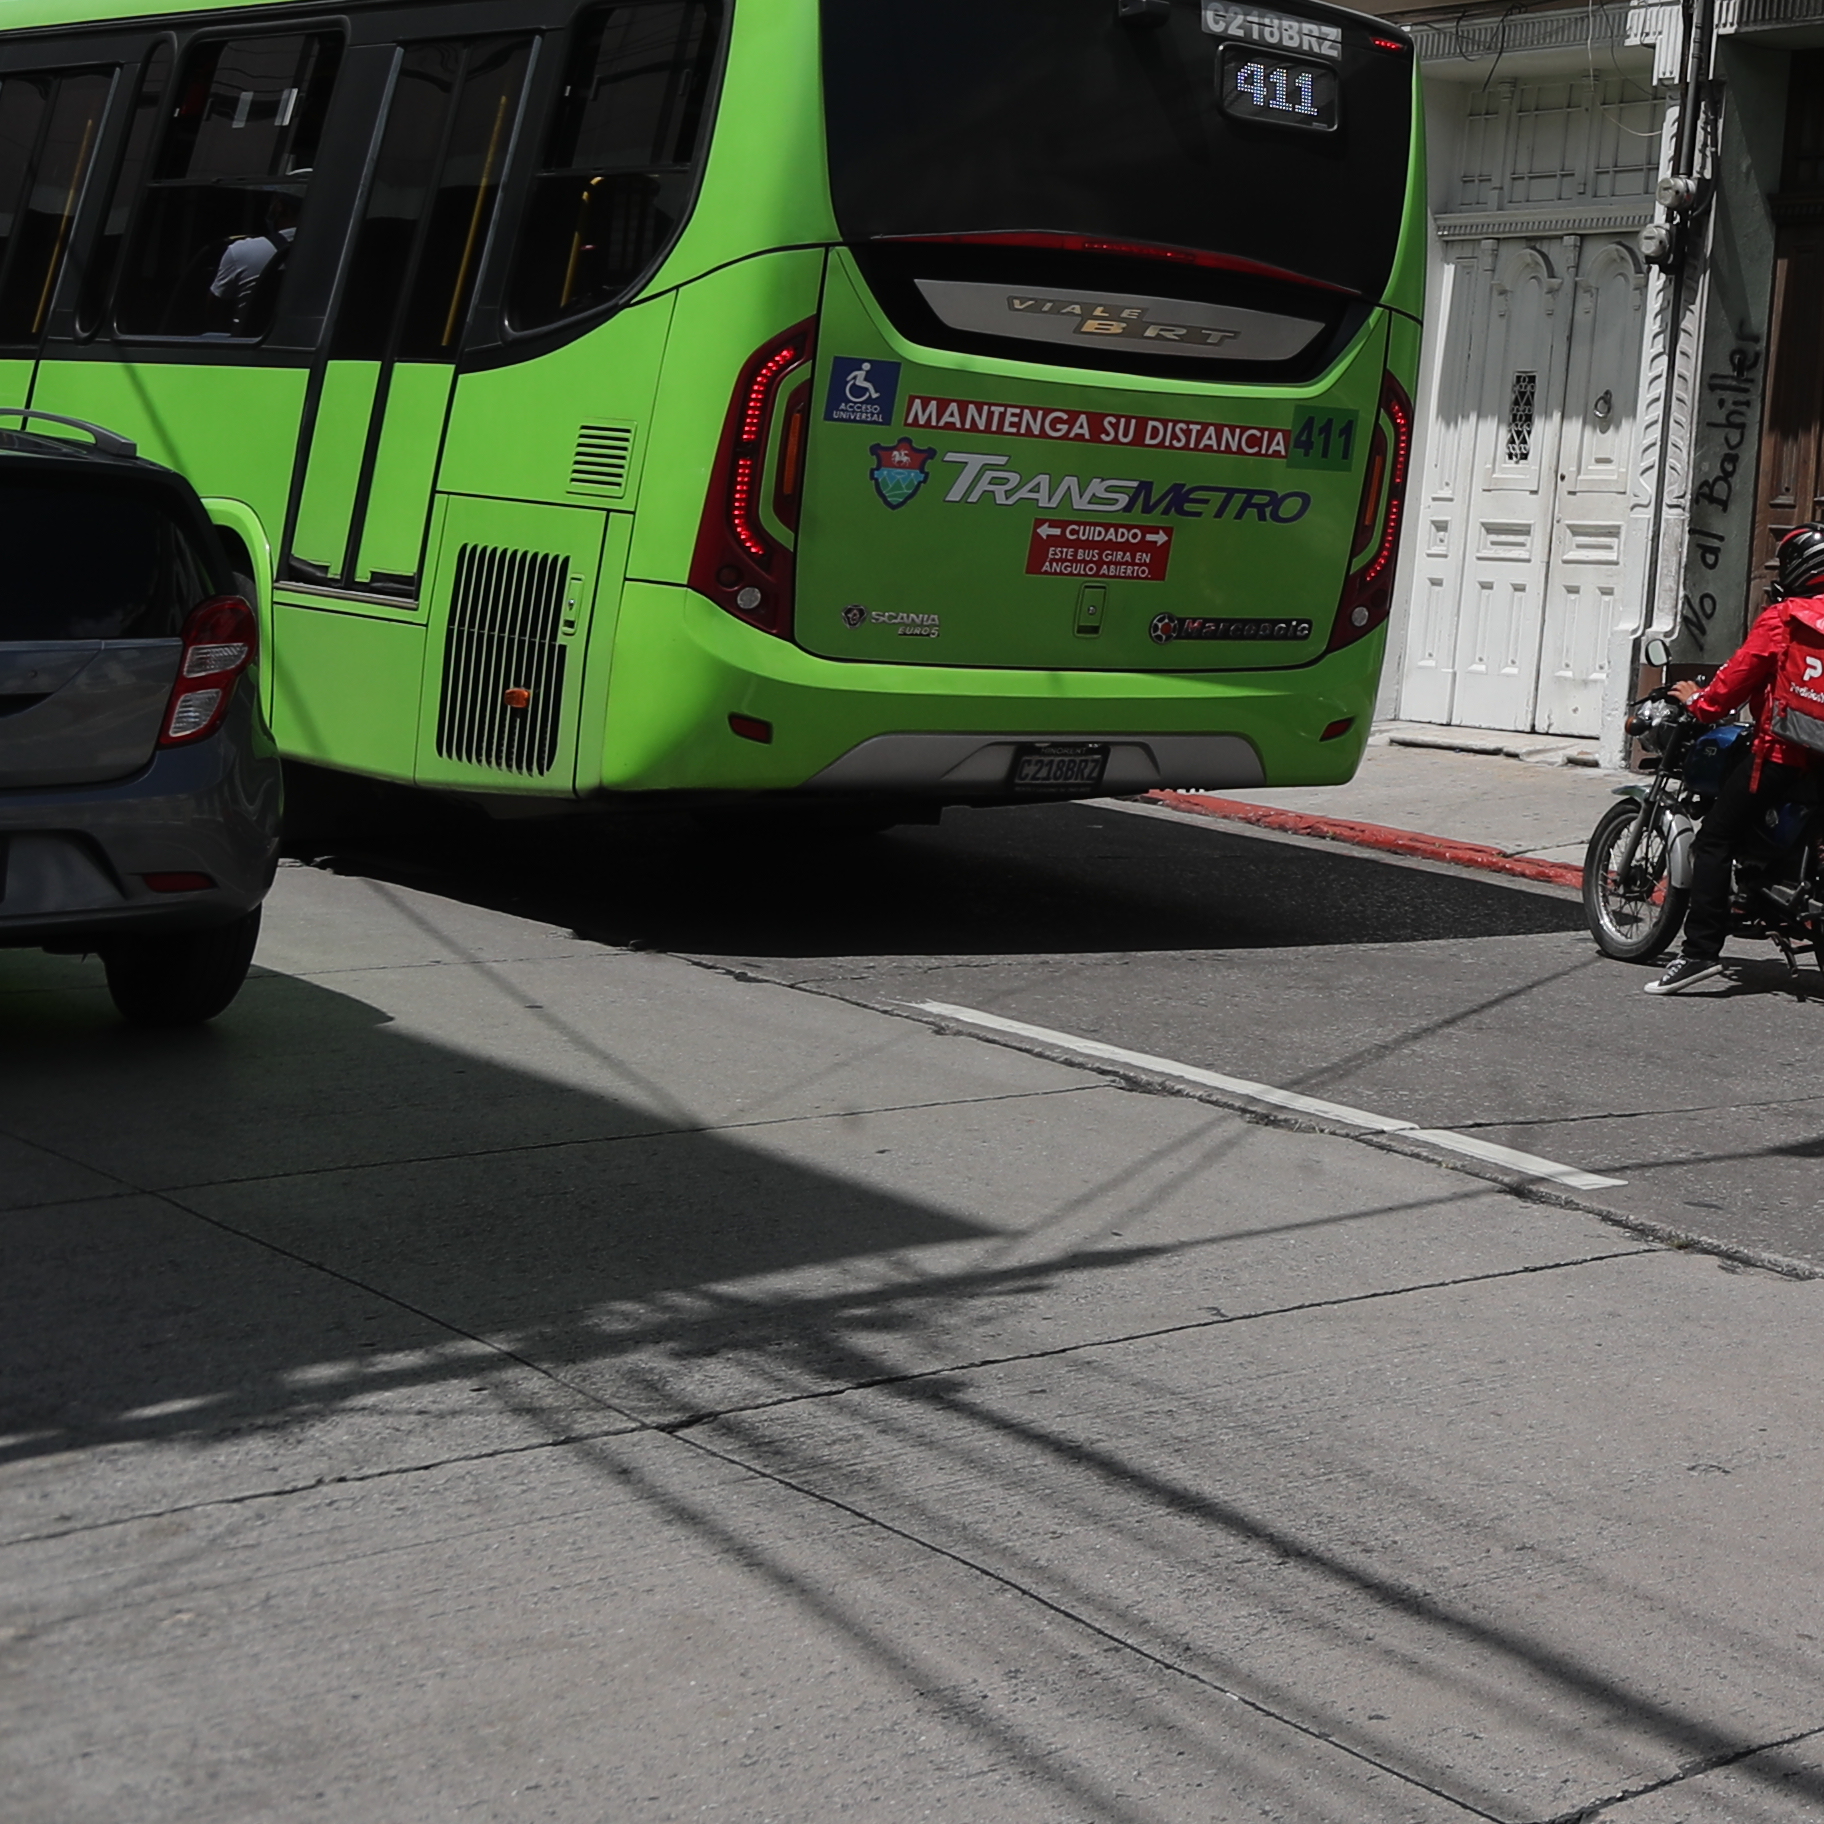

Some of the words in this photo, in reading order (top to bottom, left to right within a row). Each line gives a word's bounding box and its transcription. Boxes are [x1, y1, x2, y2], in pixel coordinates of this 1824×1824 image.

[1206, 2, 1338, 57] C218BRZ
[1237, 62, 1317, 115] 411
[1012, 299, 1142, 319] VIALE
[1080, 319, 1234, 344] BRT
[832, 410, 883, 423] UNIVERSAL
[838, 402, 881, 414] ACCESO
[1694, 318, 1761, 514] Bachiller
[906, 398, 1091, 440] MANTENGA
[1100, 415, 1136, 443] SU
[1144, 420, 1287, 456] DISTANCIA
[1293, 415, 1355, 461] 411
[942, 451, 1313, 525] TRANSMETRO
[1066, 525, 1142, 544] CUIDADO
[1048, 547, 1074, 560] ESTE
[1077, 549, 1099, 561] BUS
[1102, 550, 1132, 563] GIRA
[1135, 552, 1151, 564] EN
[1688, 527, 1725, 570] al
[1099, 564, 1152, 578] ABIERTO.
[871, 611, 939, 626] SCANIA
[1682, 593, 1717, 652] No
[1018, 759, 1100, 782] C218BRZ
